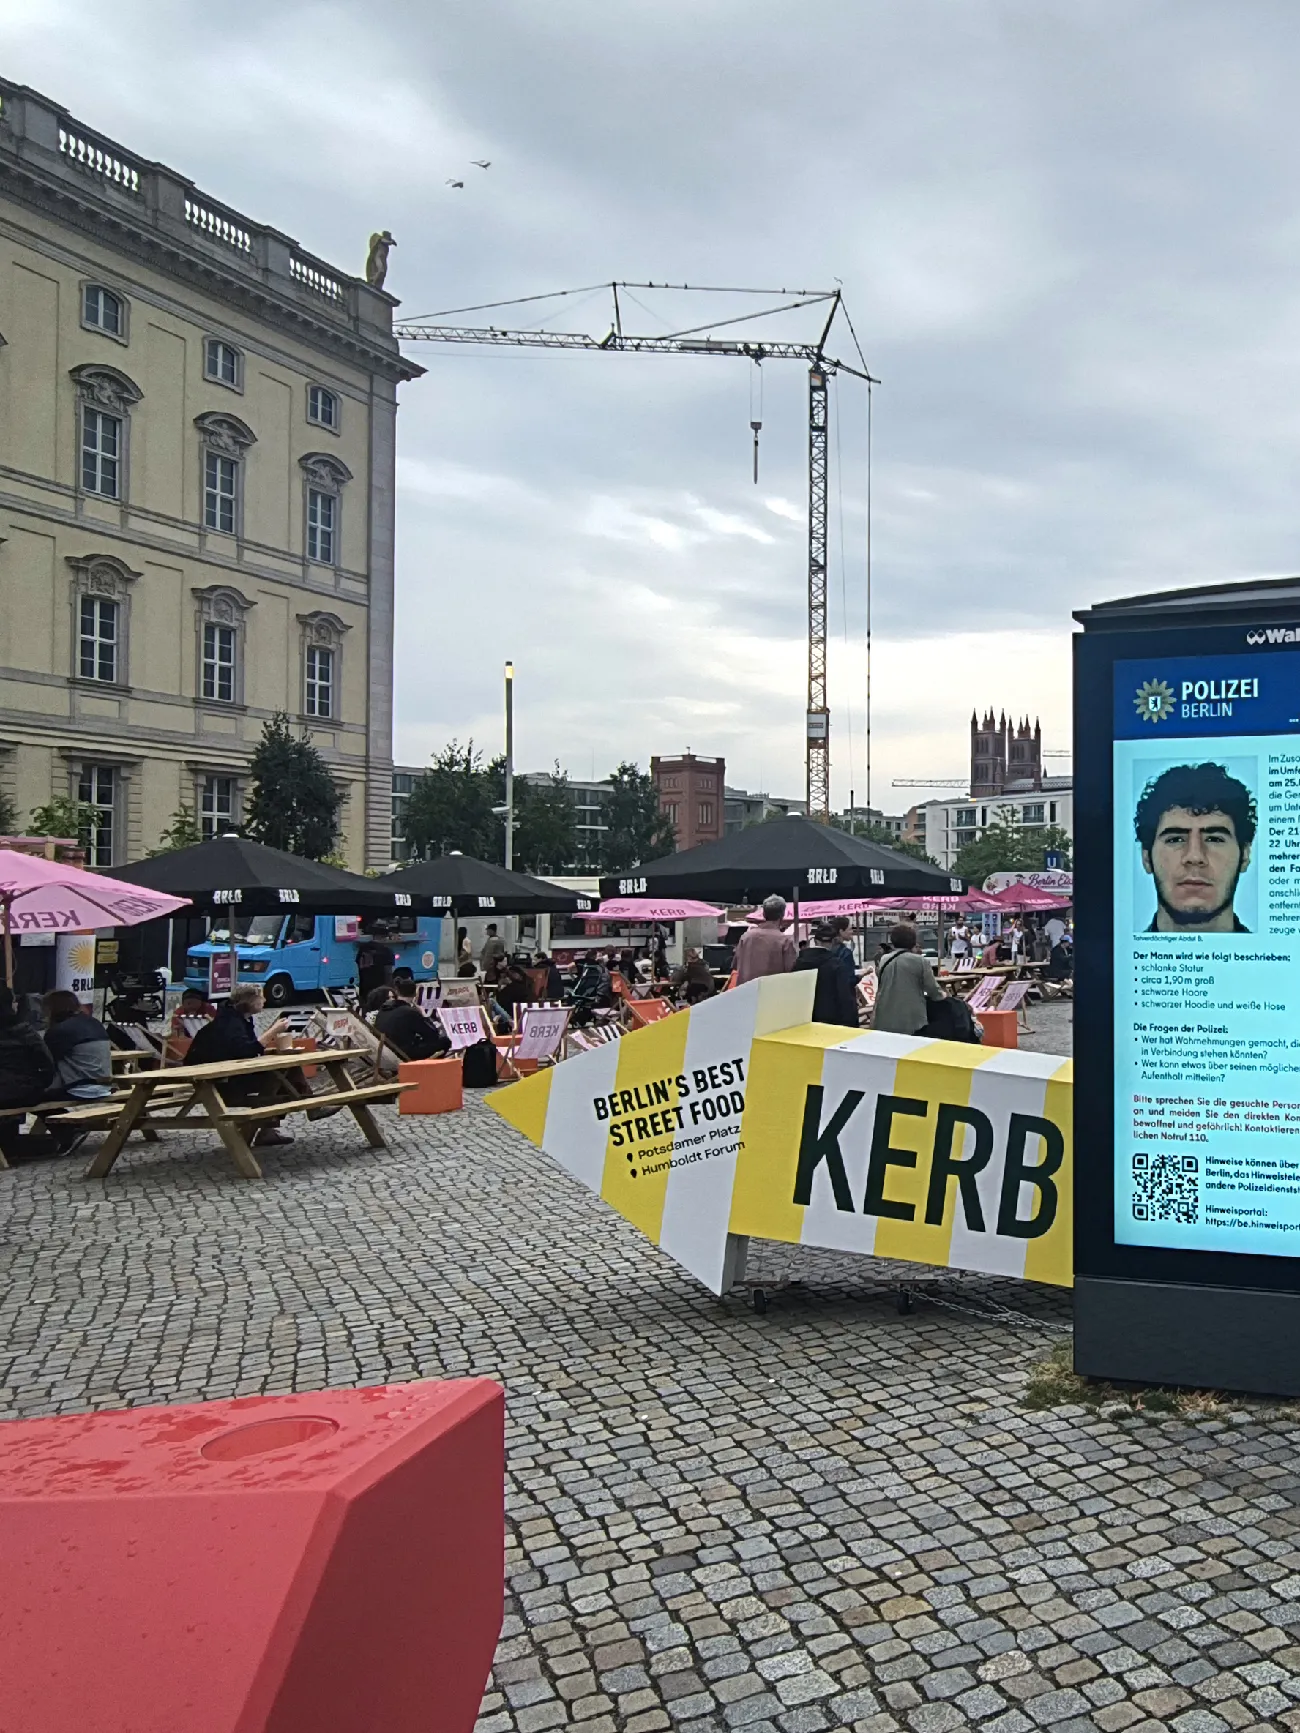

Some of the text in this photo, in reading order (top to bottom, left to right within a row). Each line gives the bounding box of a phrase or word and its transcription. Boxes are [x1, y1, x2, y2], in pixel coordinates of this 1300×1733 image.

[1181, 678, 1259, 701] POLIZEI
[1181, 702, 1232, 718] BERLIN
[1268, 754, 1279, 762] Im
[1268, 766, 1279, 774] im
[1268, 790, 1282, 799] die
[1268, 827, 1285, 836] Der
[1268, 839, 1280, 847] 22
[1284, 839, 1300, 847] Uhr
[1047, 857, 1057, 868] U
[1268, 863, 1286, 872] den
[1268, 876, 1289, 884] oder
[1268, 927, 1296, 935] zeuge
[1132, 950, 1148, 959] Der
[1149, 951, 1173, 960] Mann
[1175, 951, 1193, 960] wird
[1194, 952, 1209, 960] wie
[1211, 951, 1232, 962] folgt
[1178, 963, 1204, 973] Statur
[450, 1021, 478, 1035] KERB
[1132, 1022, 1147, 1031] Die
[1148, 1022, 1179, 1034] Fragen
[1180, 1023, 1195, 1032] der
[692, 1058, 745, 1093] BEST
[609, 1090, 745, 1147] STREET FOOD
[1147, 1106, 1165, 1116] und
[1168, 1107, 1200, 1117] meiden
[1205, 1108, 1219, 1119] Sie
[1222, 1110, 1240, 1119] den
[1243, 1110, 1280, 1121] direkten
[638, 1125, 741, 1160] Potsdamer Platz
[642, 1141, 746, 1176] Humboldt Forum
[792, 1084, 1065, 1239] KERB
[1205, 1155, 1243, 1166] Hinweise
[1244, 1157, 1278, 1168] können
[1279, 1159, 1300, 1169] über
[1204, 1167, 1233, 1179] Berlin,
[1233, 1168, 1250, 1179] das
[1205, 1179, 1236, 1191] andere
[1205, 1204, 1267, 1218] Hinweisportal:
